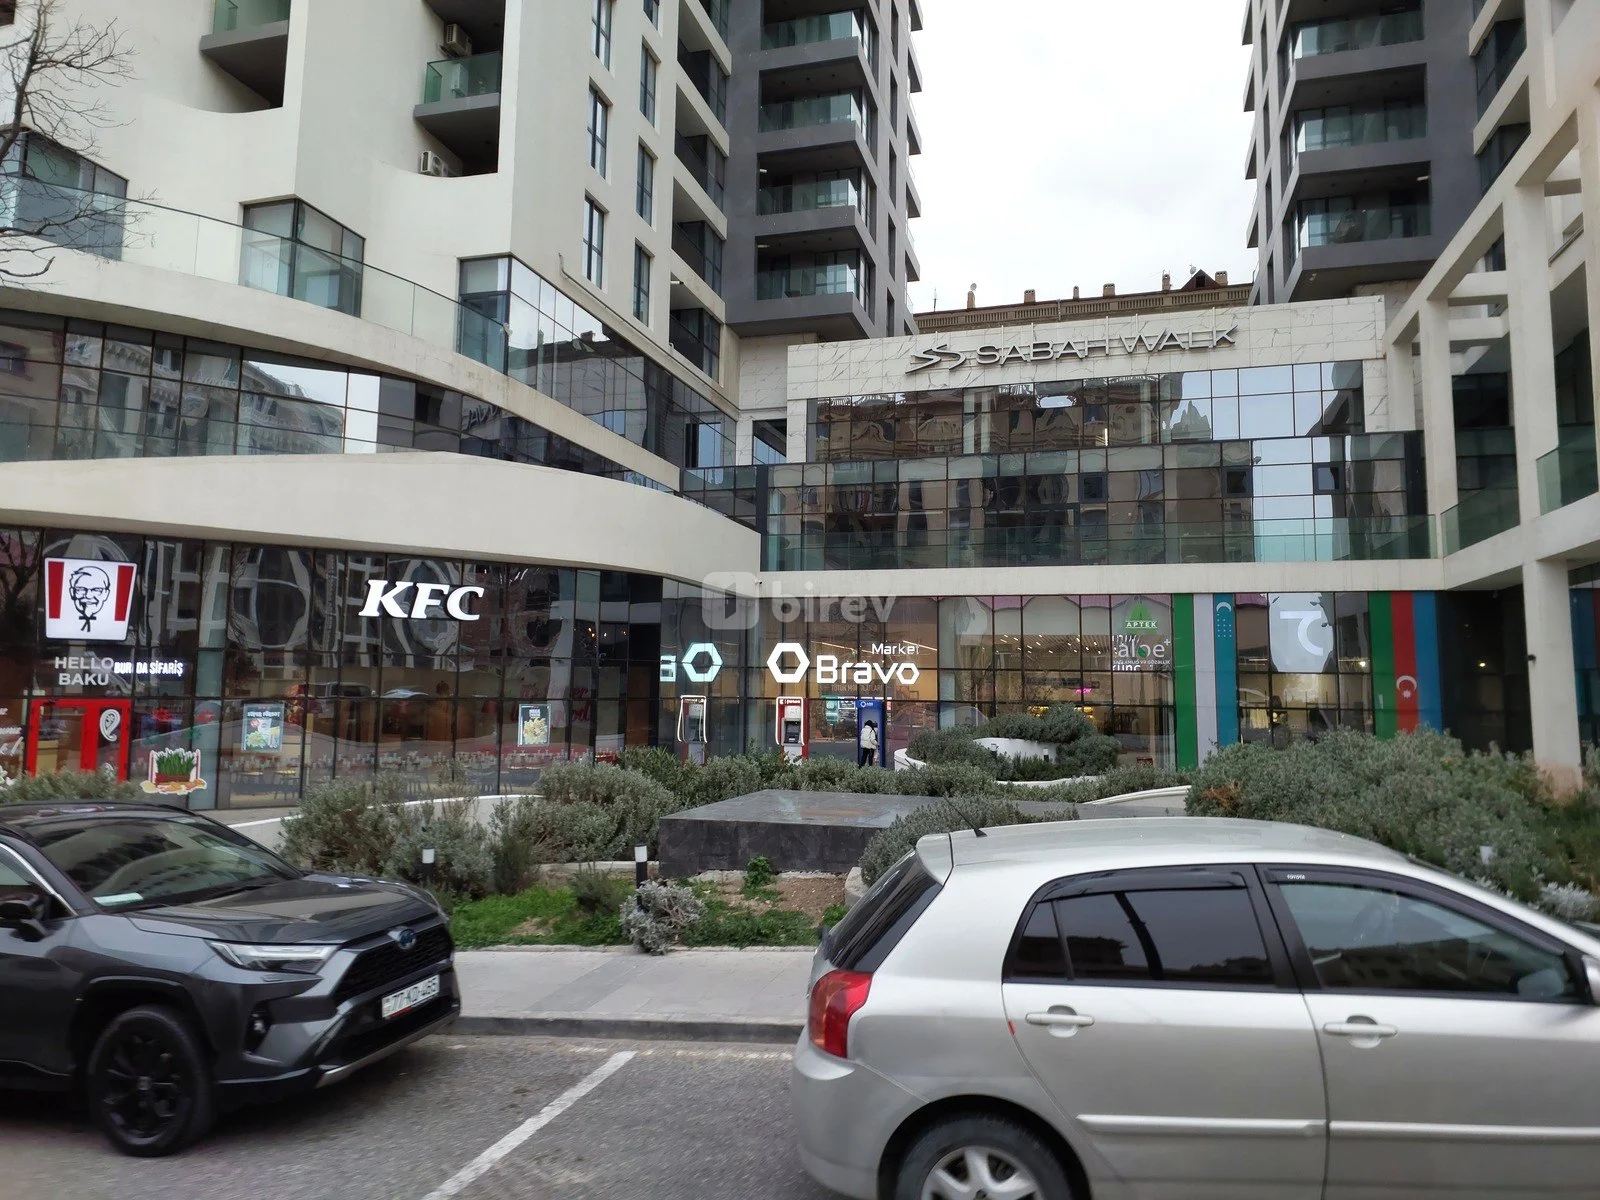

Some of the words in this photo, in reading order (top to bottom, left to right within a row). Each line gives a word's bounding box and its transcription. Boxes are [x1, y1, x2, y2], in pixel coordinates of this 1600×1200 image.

[976, 335, 1110, 366] SABAH
[1119, 323, 1239, 354] WALK
[358, 579, 484, 621] KFC
[872, 643, 920, 655] Market
[55, 656, 114, 670] HELLO
[817, 654, 920, 685] Bravo
[58, 673, 109, 686] BAKU
